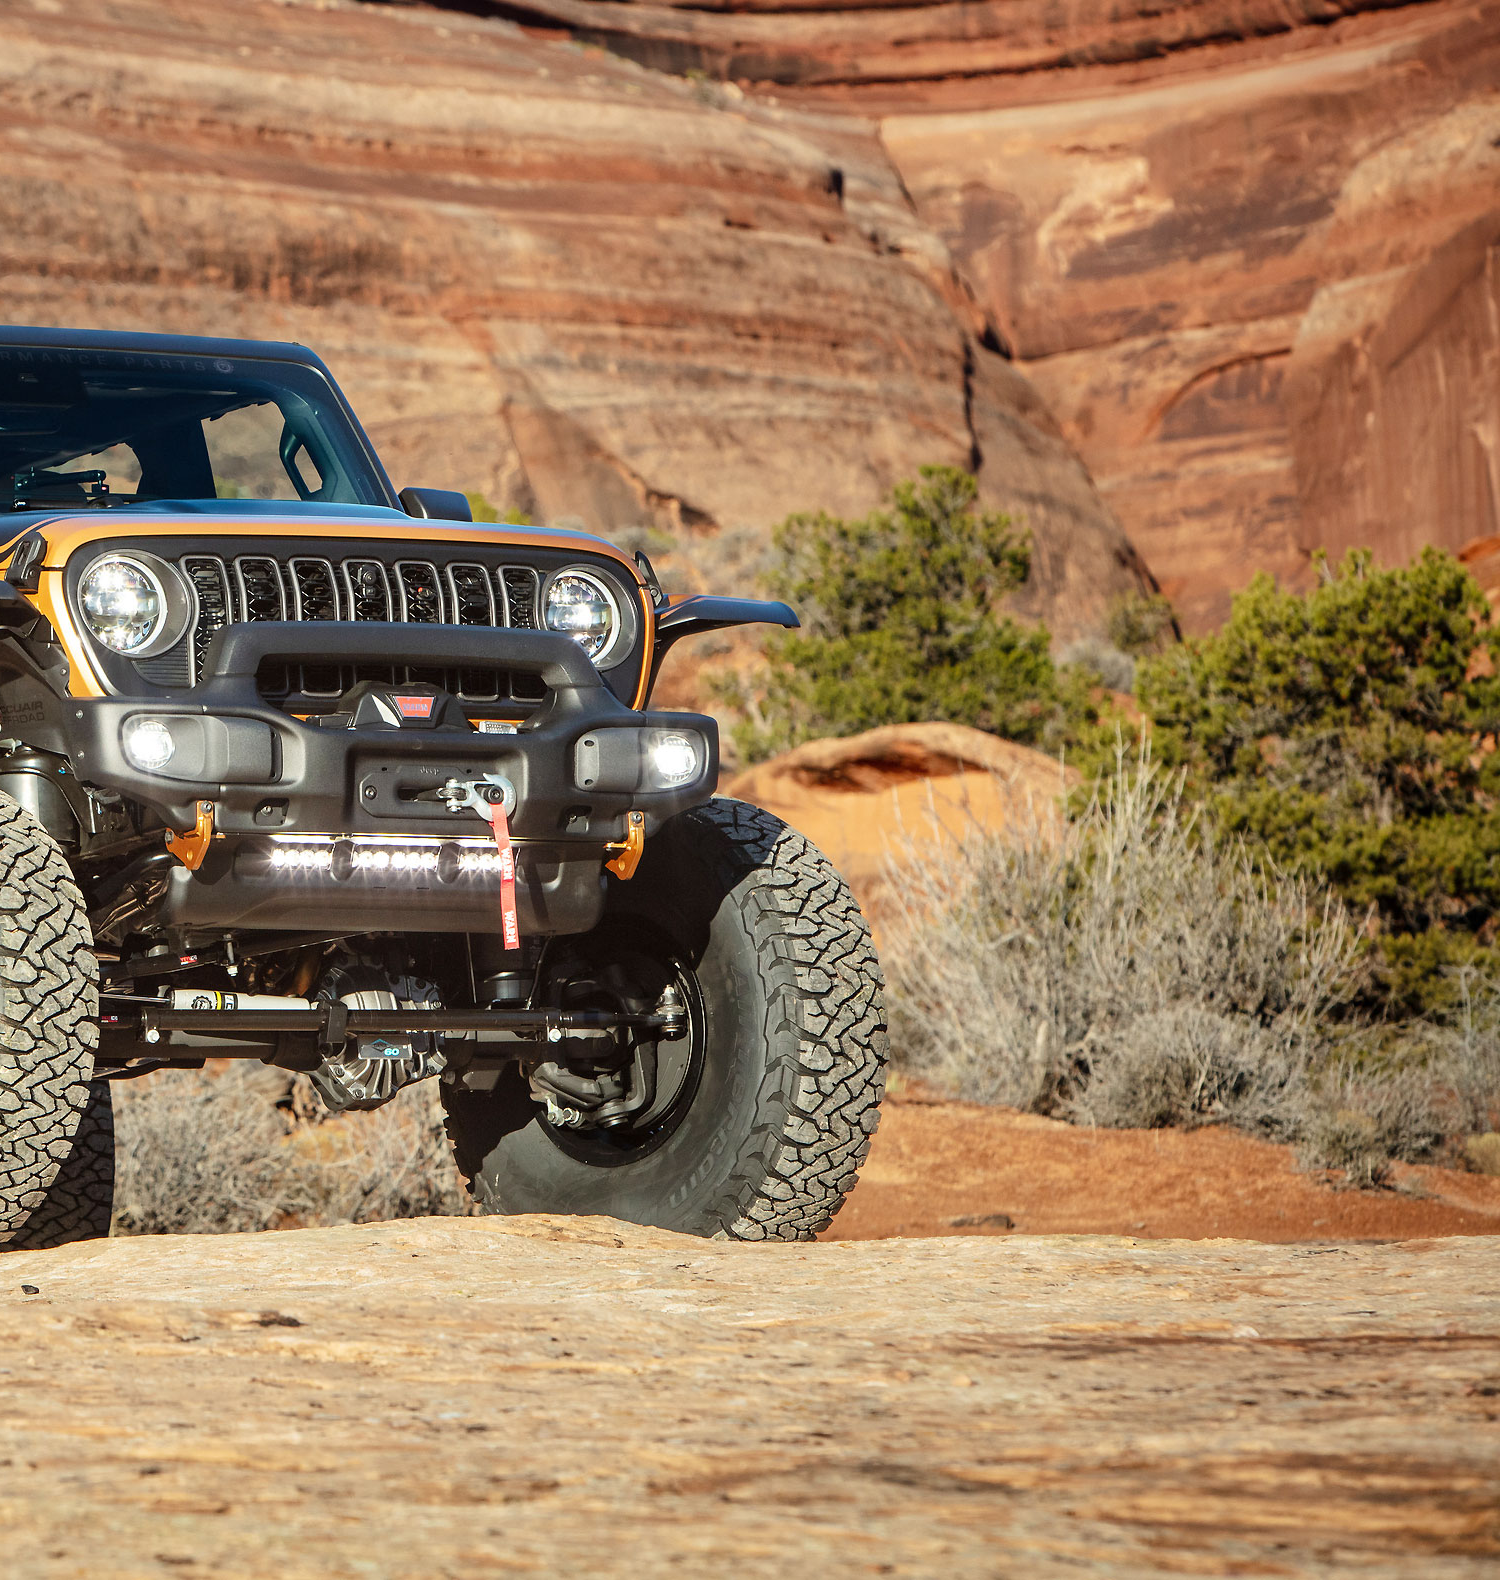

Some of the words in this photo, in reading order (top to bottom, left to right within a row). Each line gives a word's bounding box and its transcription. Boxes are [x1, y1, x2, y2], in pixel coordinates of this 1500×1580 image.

[123, 356, 206, 372] PARTS
[0, 701, 43, 714] CCUAIR
[3, 712, 45, 725] FFROAD
[501, 847, 513, 880] WARN
[505, 910, 517, 943] WARN
[383, 1047, 400, 1056] 60
